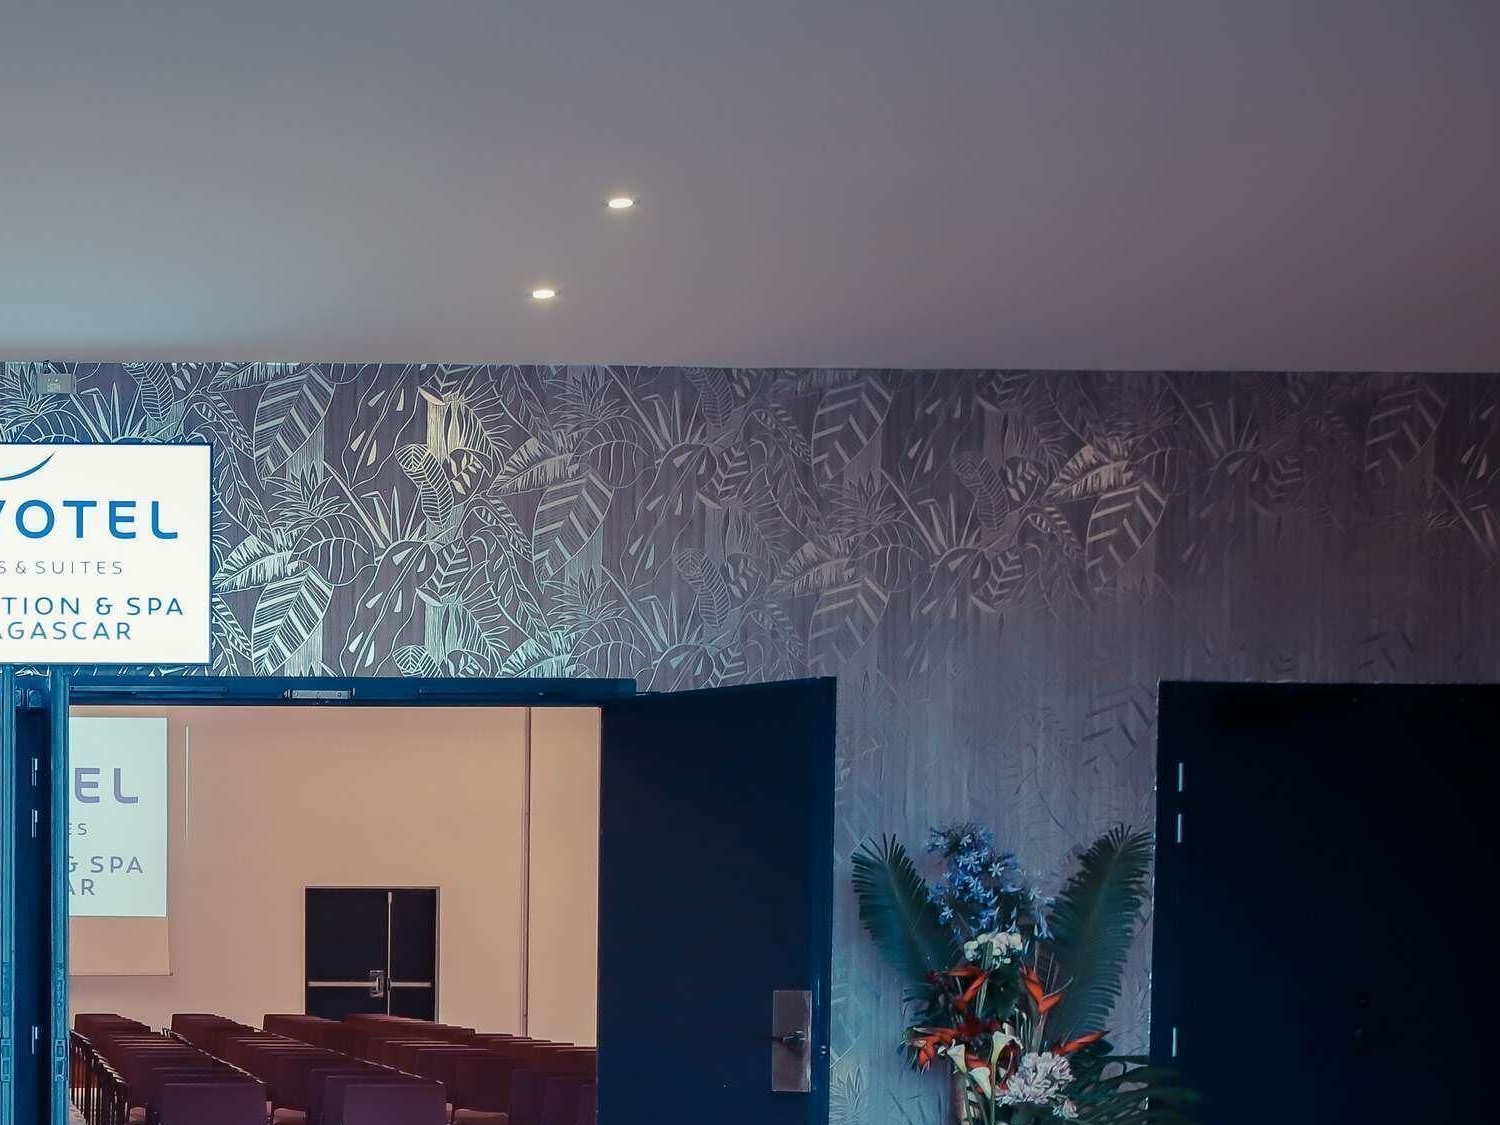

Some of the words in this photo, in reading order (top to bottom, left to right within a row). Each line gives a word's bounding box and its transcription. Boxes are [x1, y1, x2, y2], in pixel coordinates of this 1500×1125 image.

[95, 597, 113, 616] &
[126, 597, 185, 616] SPA
[90, 856, 144, 874] SPA
